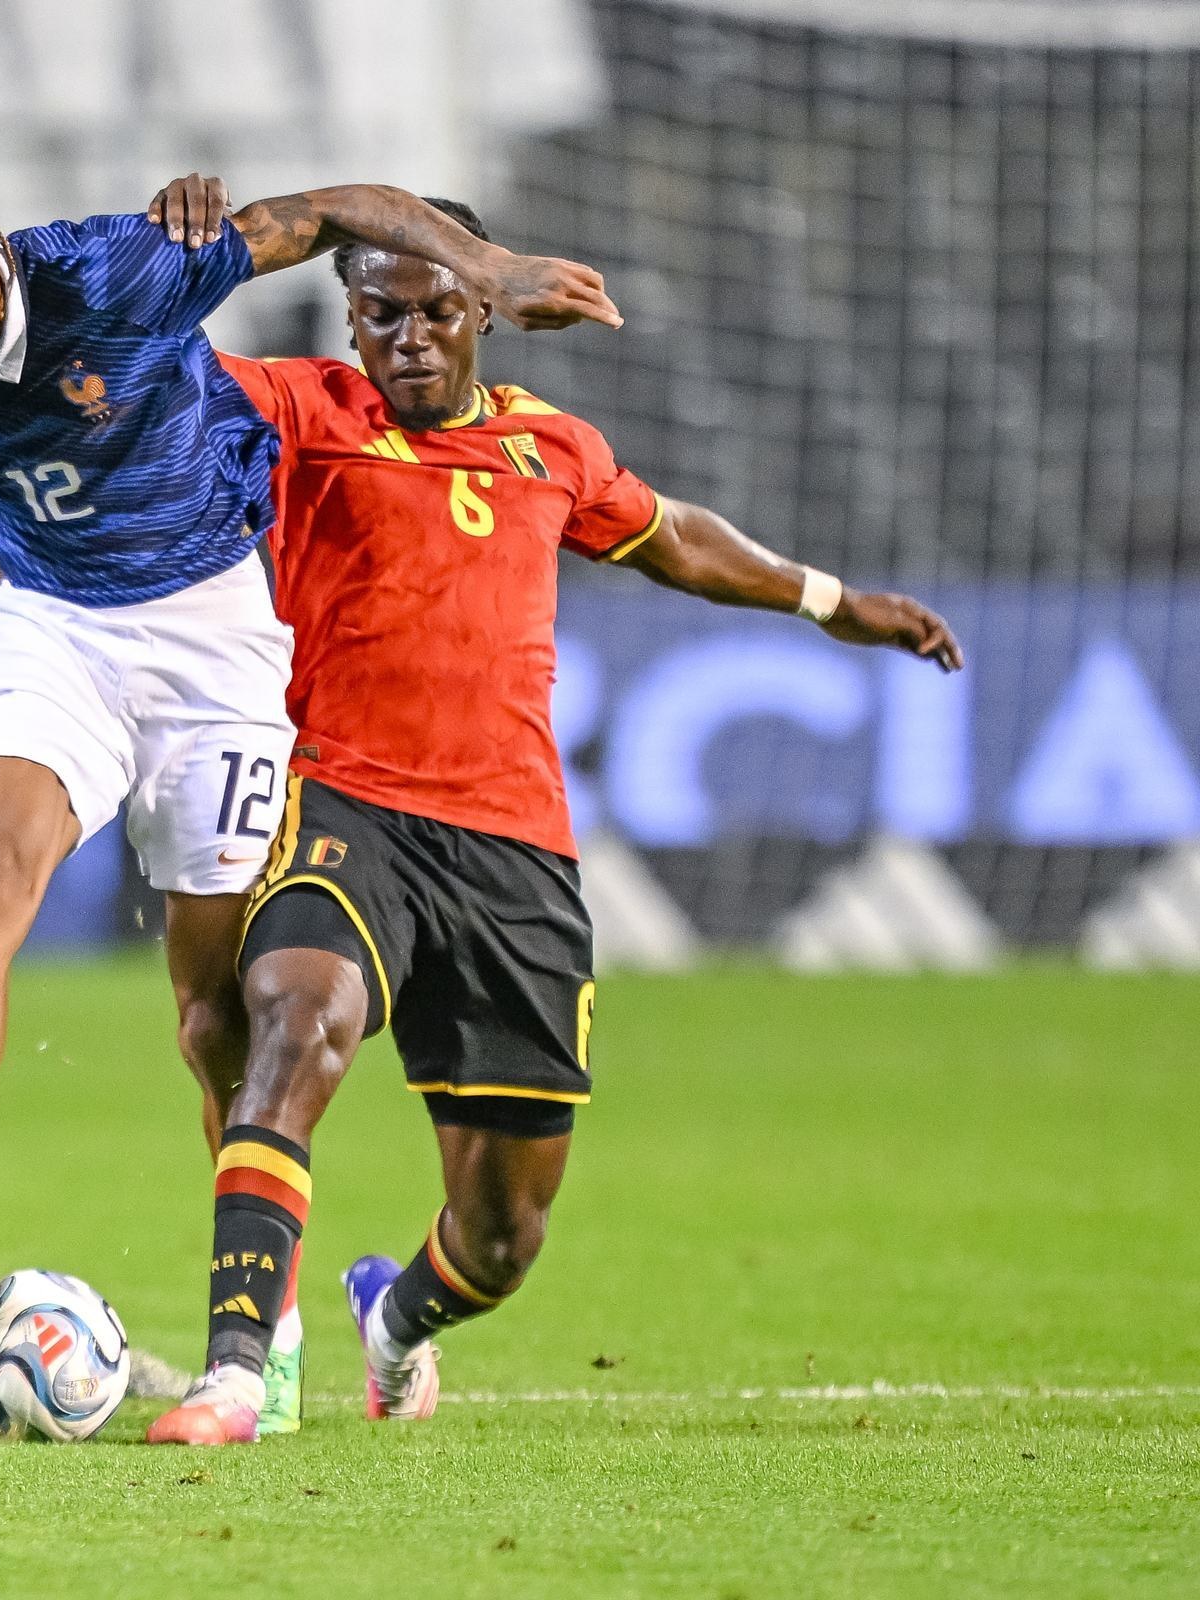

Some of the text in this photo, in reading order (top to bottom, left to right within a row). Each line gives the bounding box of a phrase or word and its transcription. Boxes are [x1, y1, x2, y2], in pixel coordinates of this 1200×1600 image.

[6, 461, 95, 522] 12
[450, 468, 495, 537] 6
[216, 751, 276, 840] 12
[211, 1252, 275, 1273] RBFA
